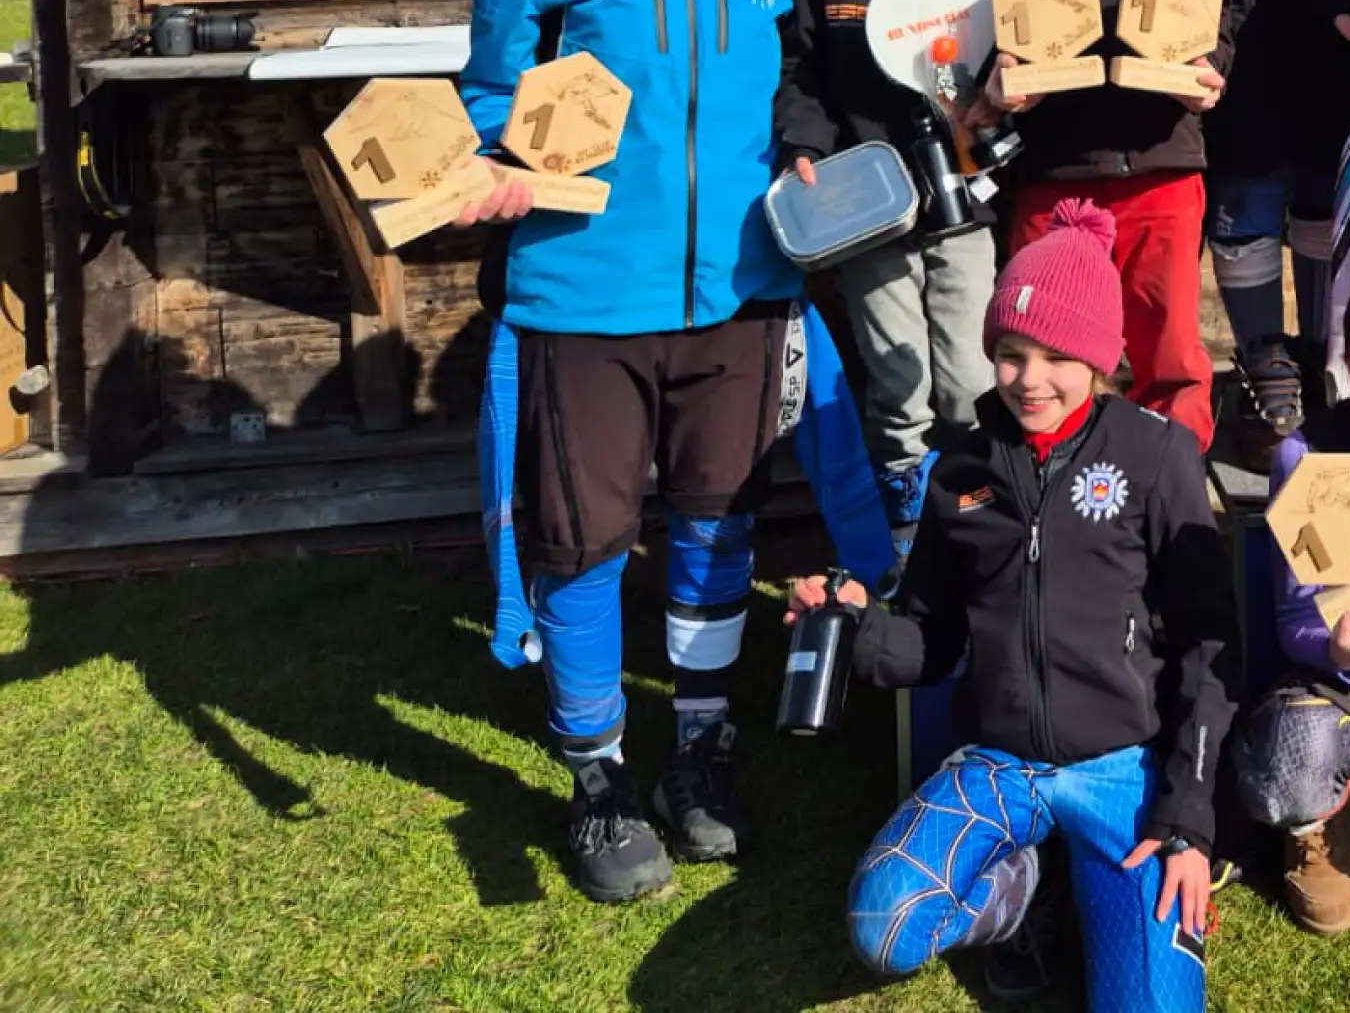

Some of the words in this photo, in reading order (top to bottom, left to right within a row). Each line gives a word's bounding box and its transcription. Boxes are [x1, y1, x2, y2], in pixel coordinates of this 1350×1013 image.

[1000, 1, 1030, 46] 1
[522, 102, 556, 151] 1
[350, 136, 396, 185] 1
[1291, 520, 1333, 574] 1
